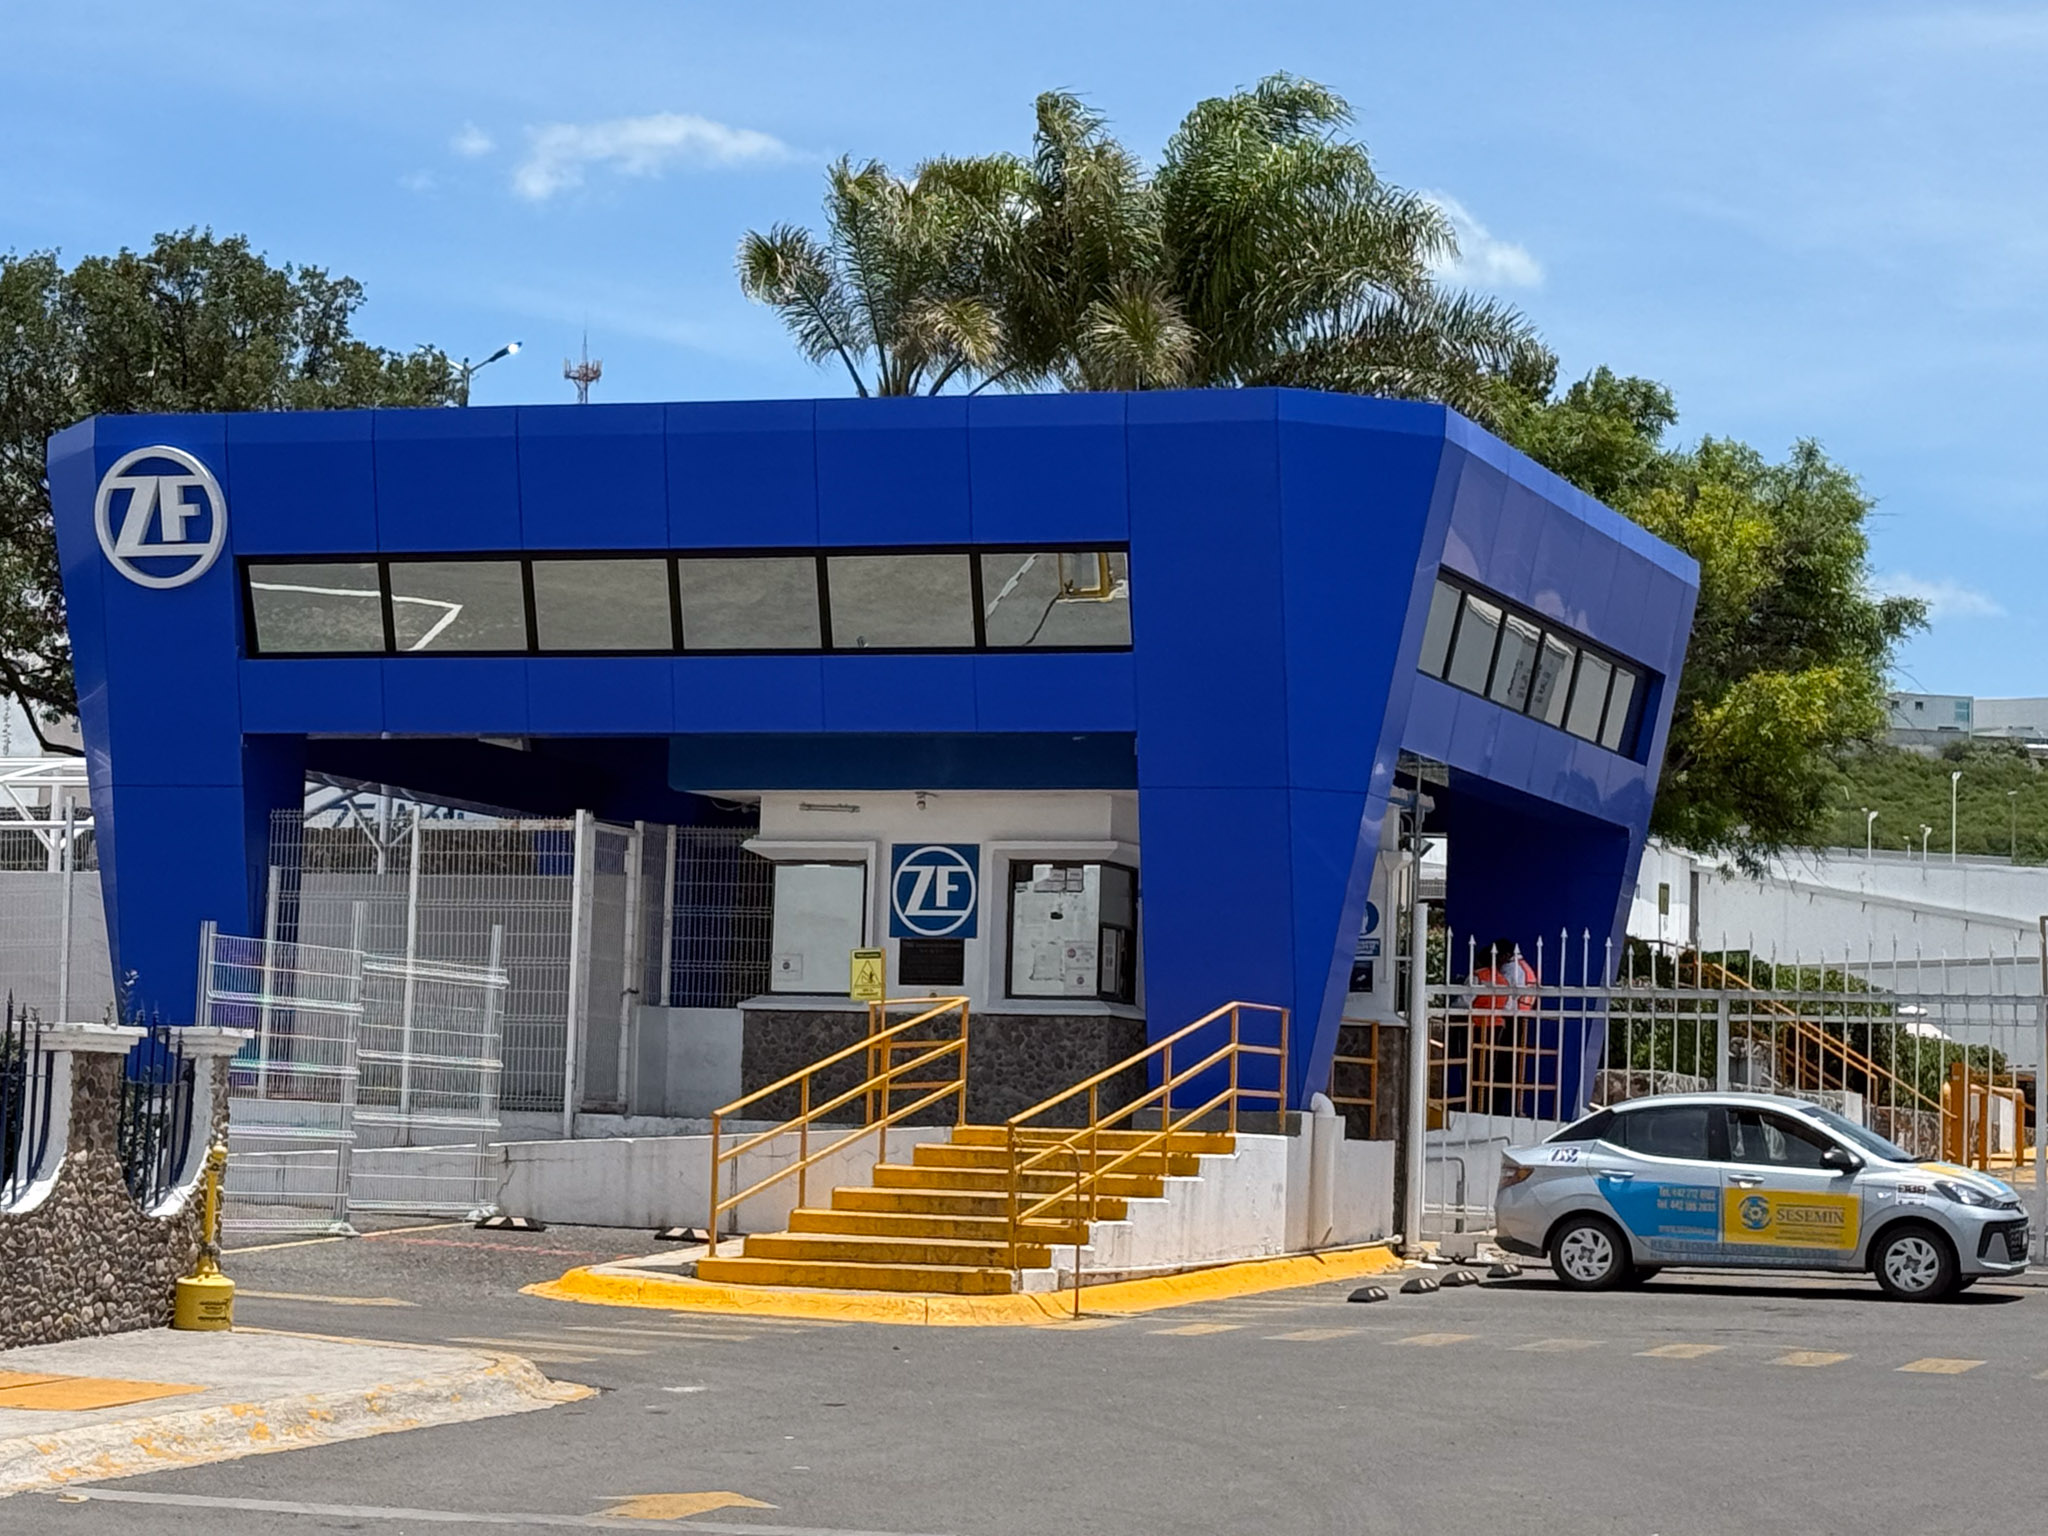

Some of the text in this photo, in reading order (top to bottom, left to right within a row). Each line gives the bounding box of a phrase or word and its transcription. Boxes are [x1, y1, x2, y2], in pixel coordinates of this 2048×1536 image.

[105, 471, 214, 562] ZF
[899, 863, 971, 918] ZF
[1776, 1208, 1845, 1224] SESEMIN
